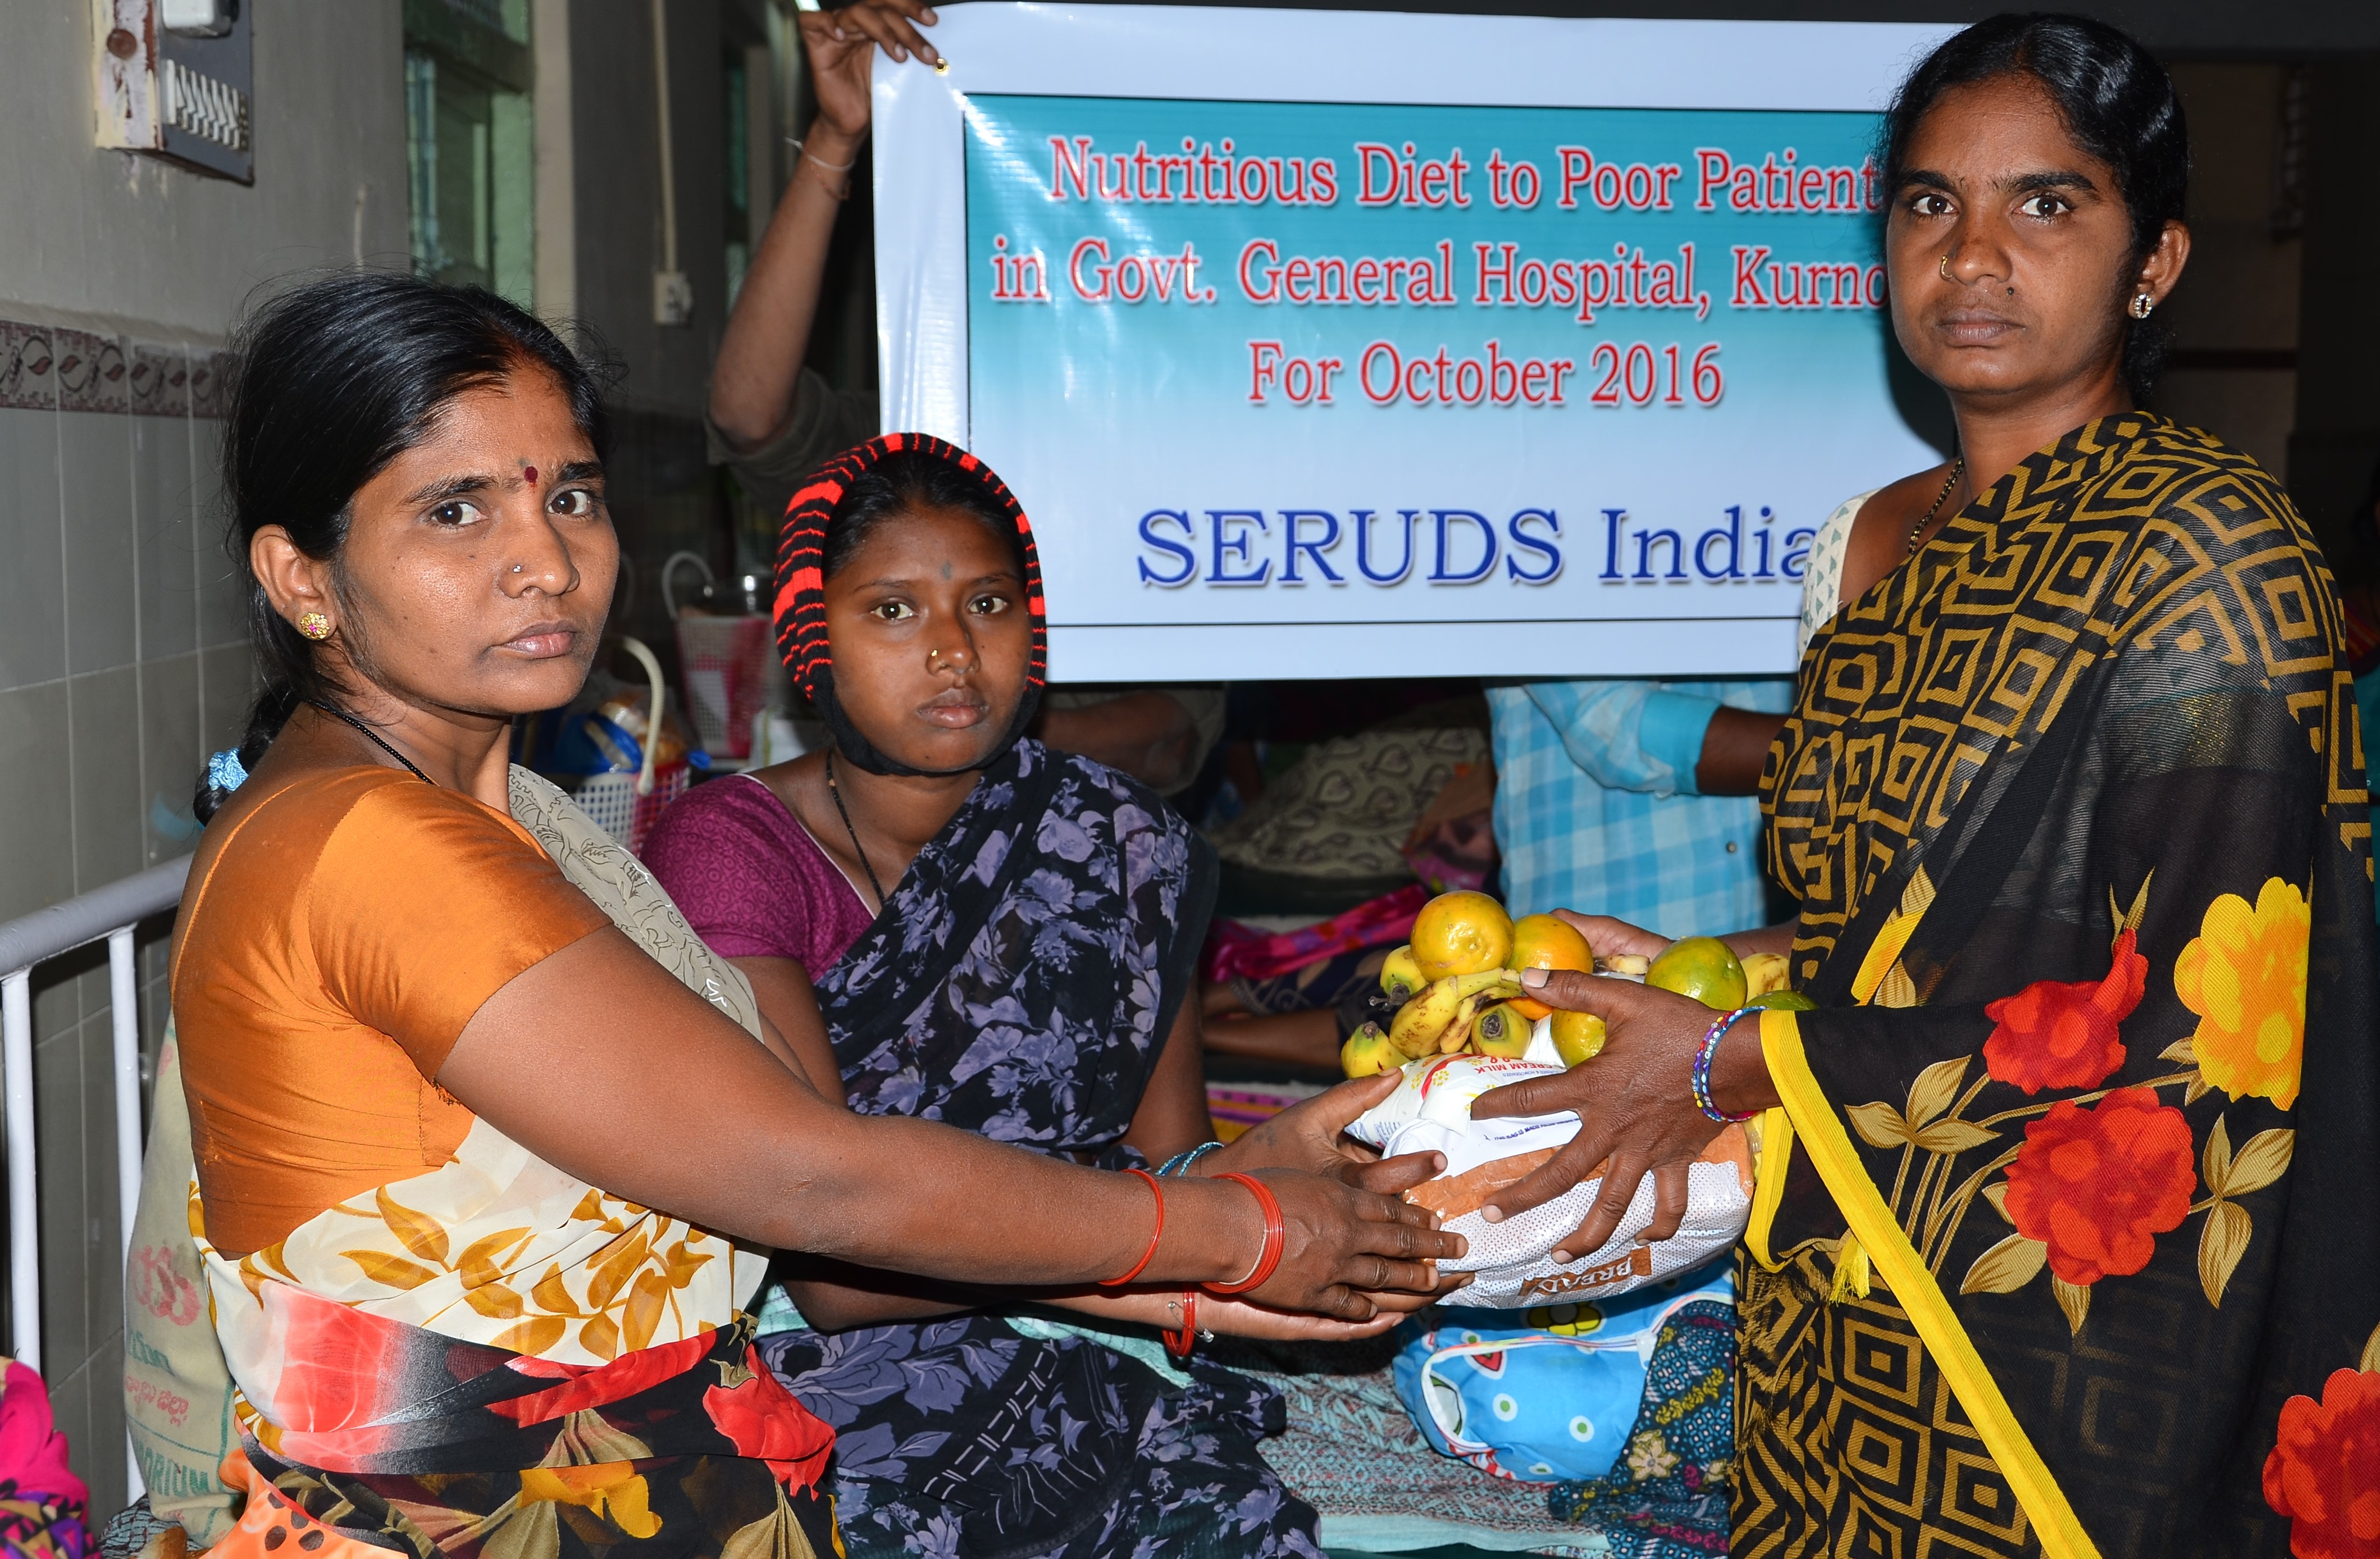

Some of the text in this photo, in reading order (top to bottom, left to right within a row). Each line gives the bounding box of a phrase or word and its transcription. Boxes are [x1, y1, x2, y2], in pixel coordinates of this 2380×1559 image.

[1050, 139, 1881, 211] Nutritious Diet to Poor Patient
[993, 237, 1888, 322] in Govt. General Hospital, Kurno
[1249, 341, 1722, 404] For October 2016
[1137, 504, 1817, 584] SERUDS India
[1474, 1064, 1507, 1074] MILK
[1538, 1257, 1632, 1293] BREAD
